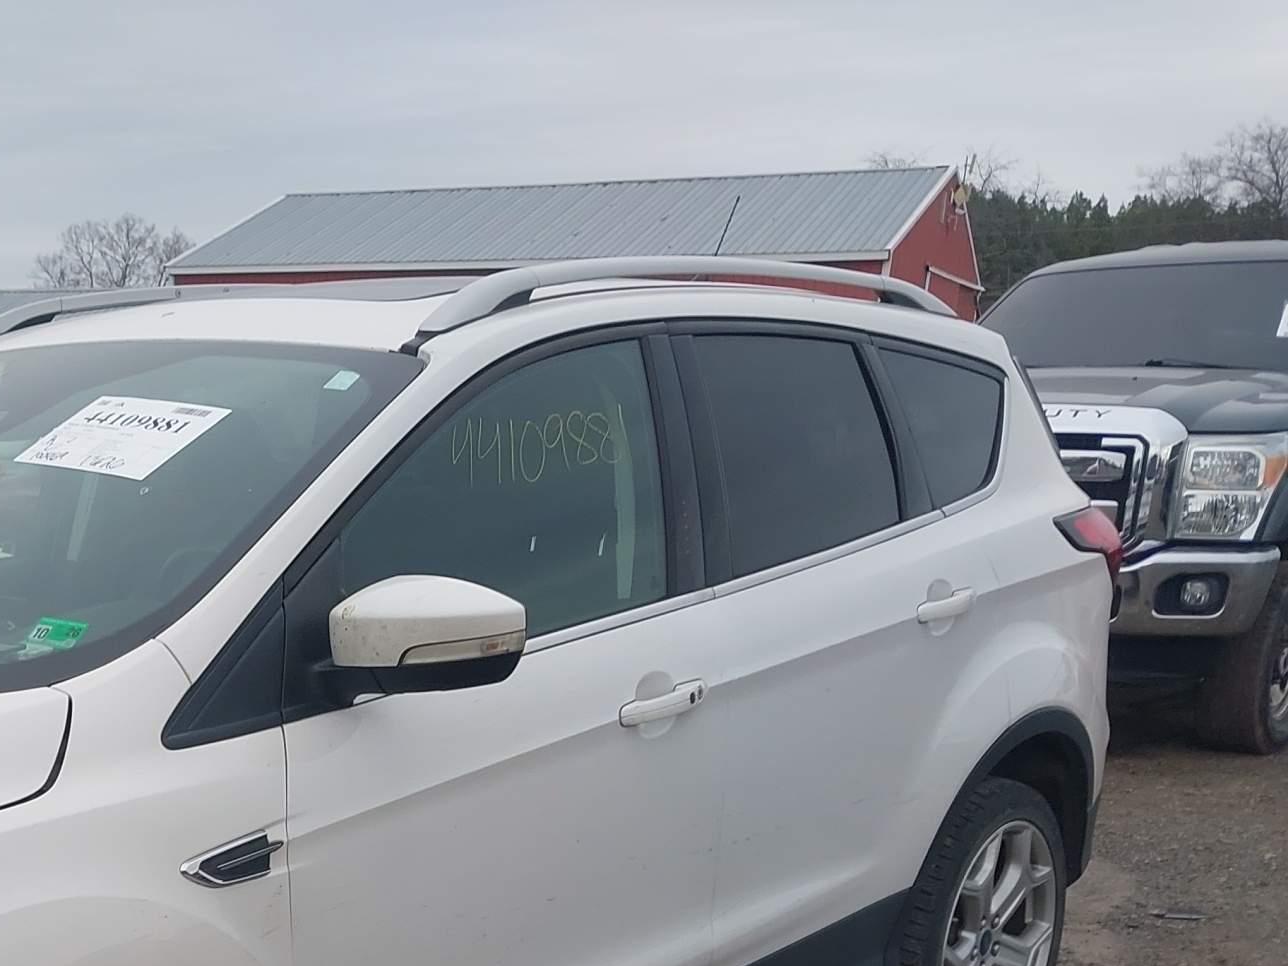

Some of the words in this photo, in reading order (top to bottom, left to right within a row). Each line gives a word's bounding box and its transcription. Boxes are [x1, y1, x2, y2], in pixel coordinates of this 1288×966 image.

[83, 410, 192, 435] 44109881
[452, 403, 630, 488] 44109881
[33, 627, 50, 640] 10
